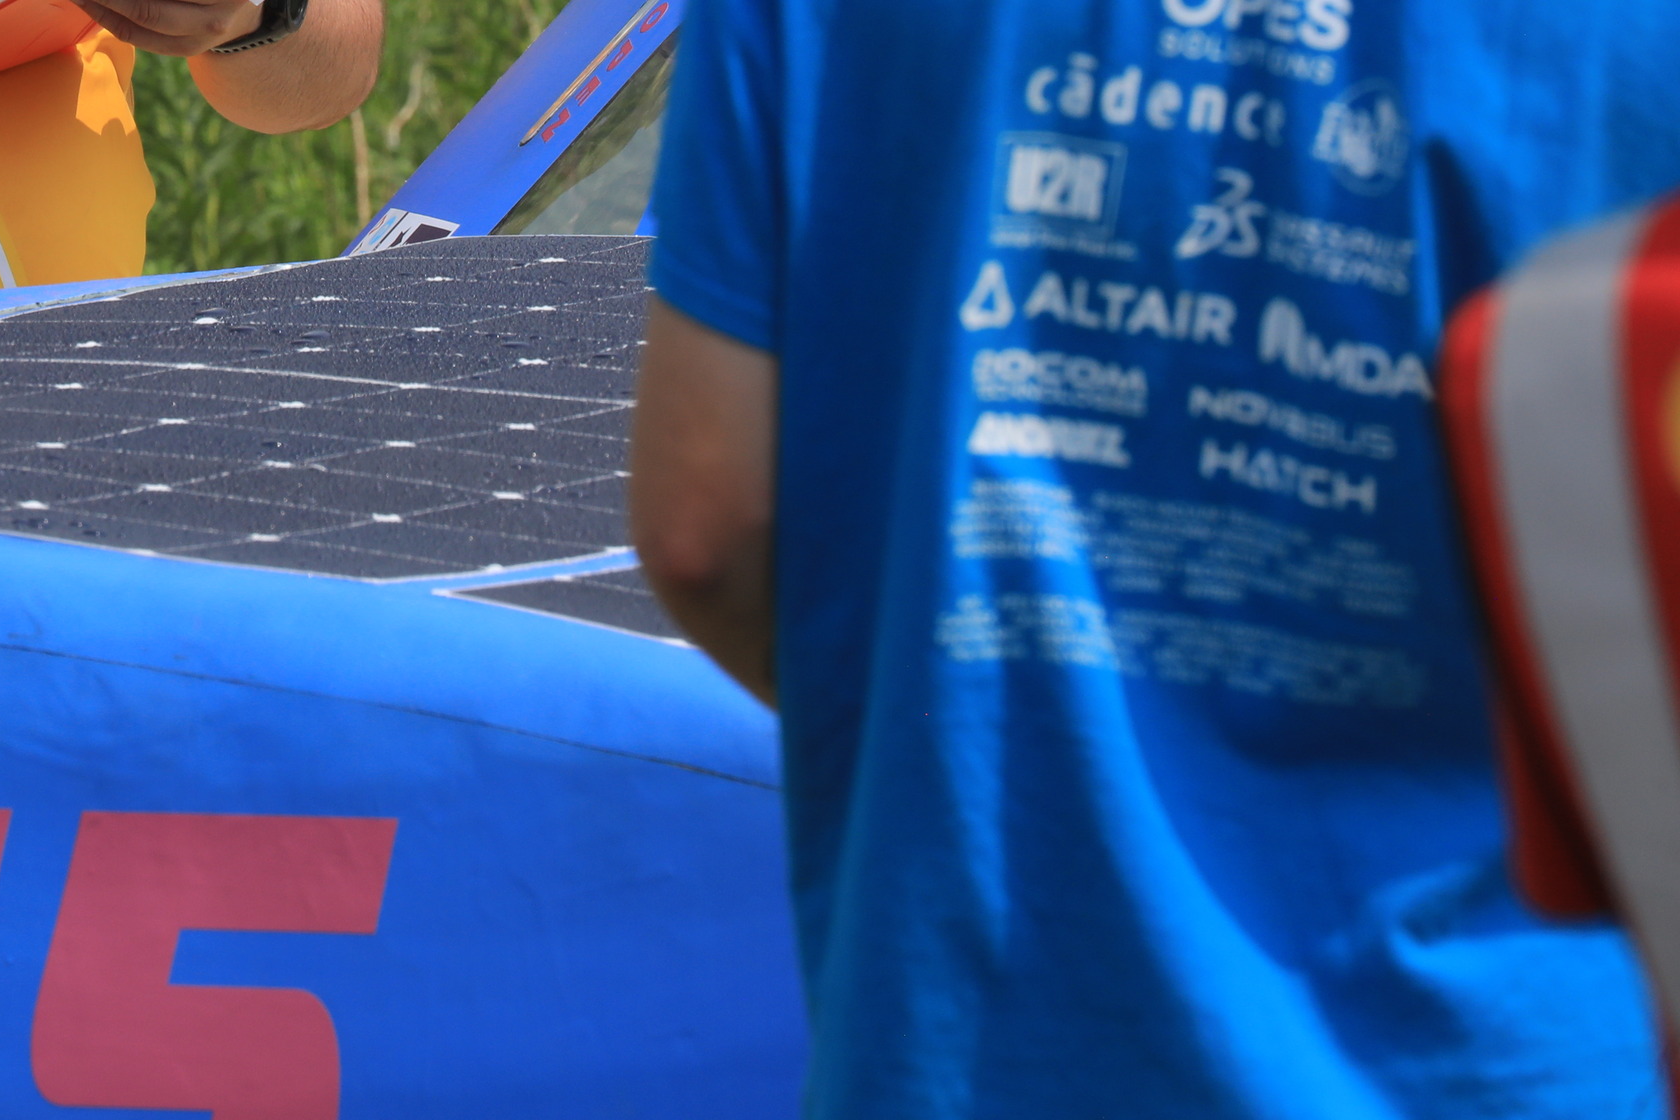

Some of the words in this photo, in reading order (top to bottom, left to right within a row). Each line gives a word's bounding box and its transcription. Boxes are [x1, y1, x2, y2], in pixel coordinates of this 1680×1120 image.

[540, 1, 669, 144] OPEN
[1023, 271, 1238, 346] ALTAIR
[1199, 437, 1378, 515] HATCH
